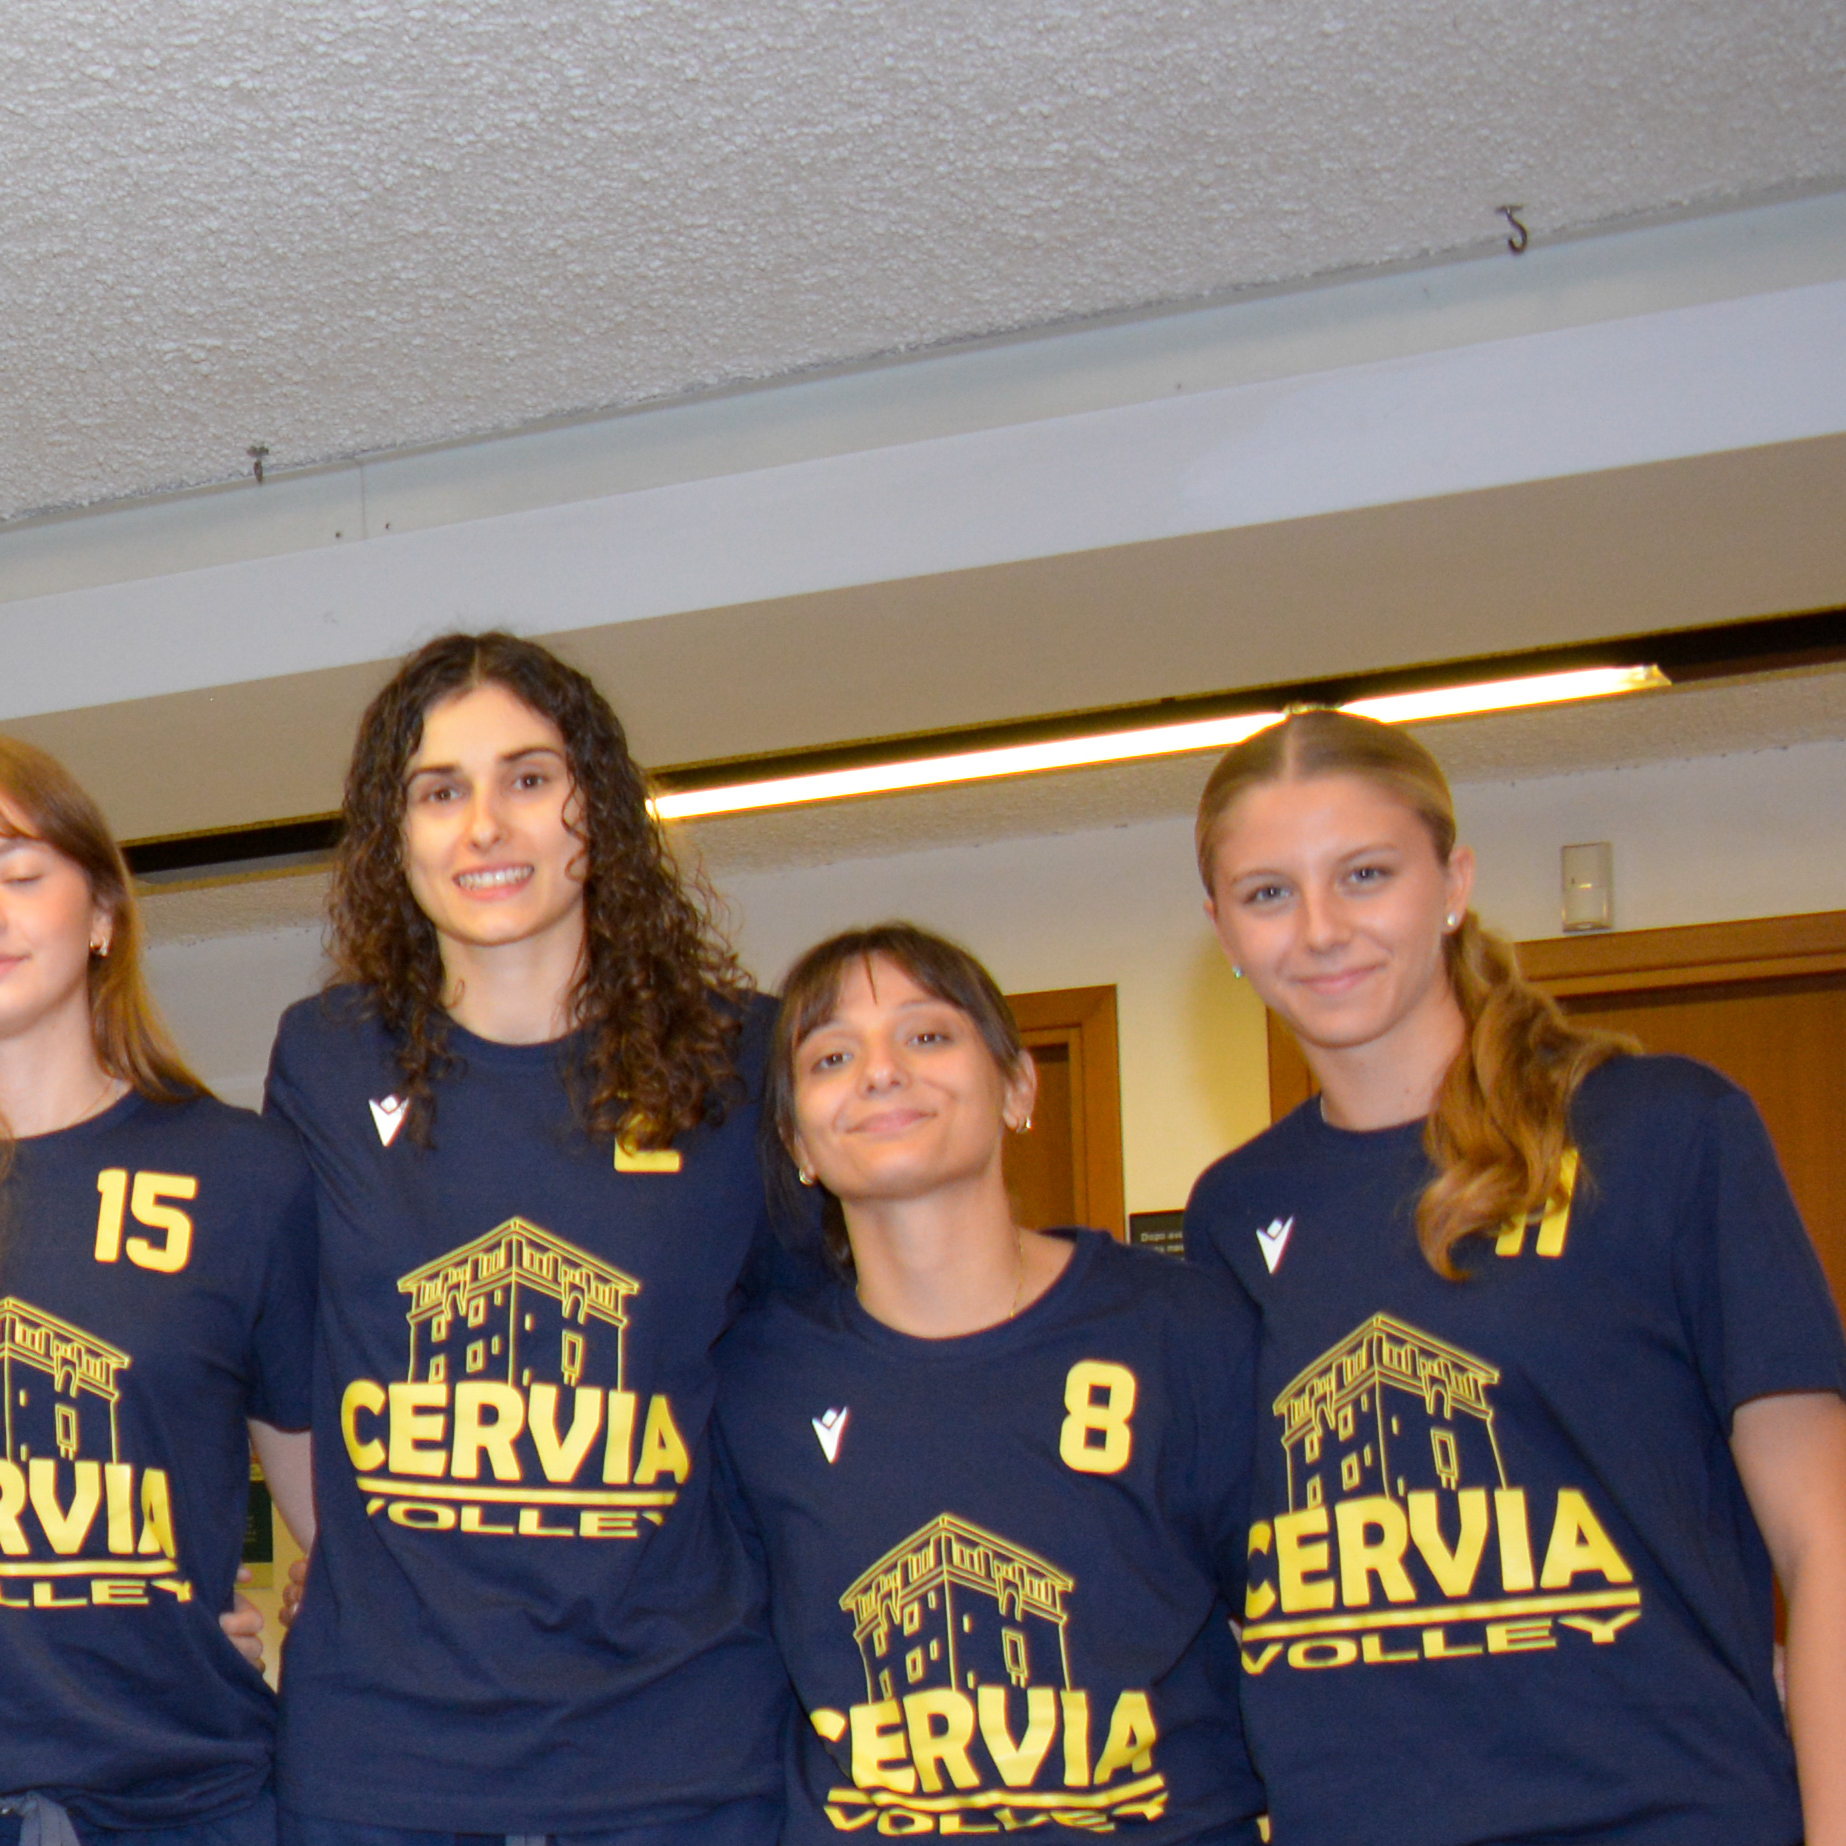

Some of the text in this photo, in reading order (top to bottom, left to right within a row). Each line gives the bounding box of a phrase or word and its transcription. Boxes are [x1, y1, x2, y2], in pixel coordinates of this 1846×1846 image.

[95, 1168, 198, 1273] 15
[339, 1378, 692, 1485] CERVIA
[1058, 1359, 1138, 1474] 8
[365, 1497, 665, 1538] OLLE
[1244, 1487, 1635, 1620] CERVIA
[1240, 1609, 1643, 1675] VOLLEY
